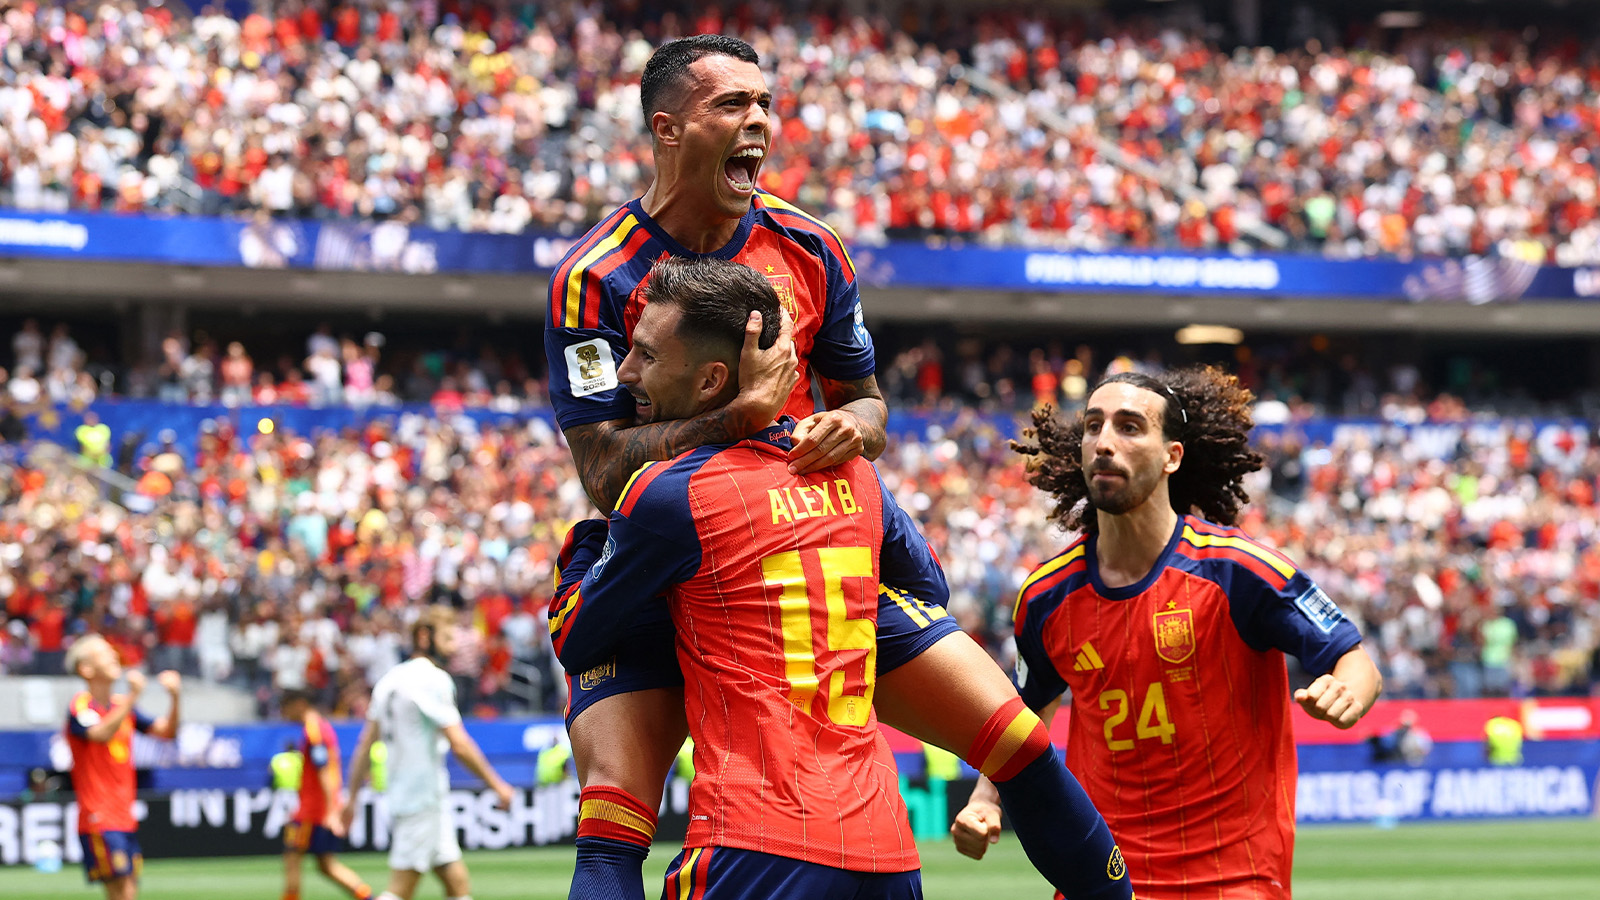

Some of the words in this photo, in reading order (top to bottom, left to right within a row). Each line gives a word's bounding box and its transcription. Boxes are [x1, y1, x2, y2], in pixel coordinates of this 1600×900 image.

[583, 381, 606, 391] 2026
[767, 481, 837, 525] ALEX
[834, 478, 863, 515] B.
[761, 546, 877, 727] 15
[1099, 682, 1176, 751] 24
[170, 787, 227, 828] IN
[1431, 766, 1589, 816] AMERICA
